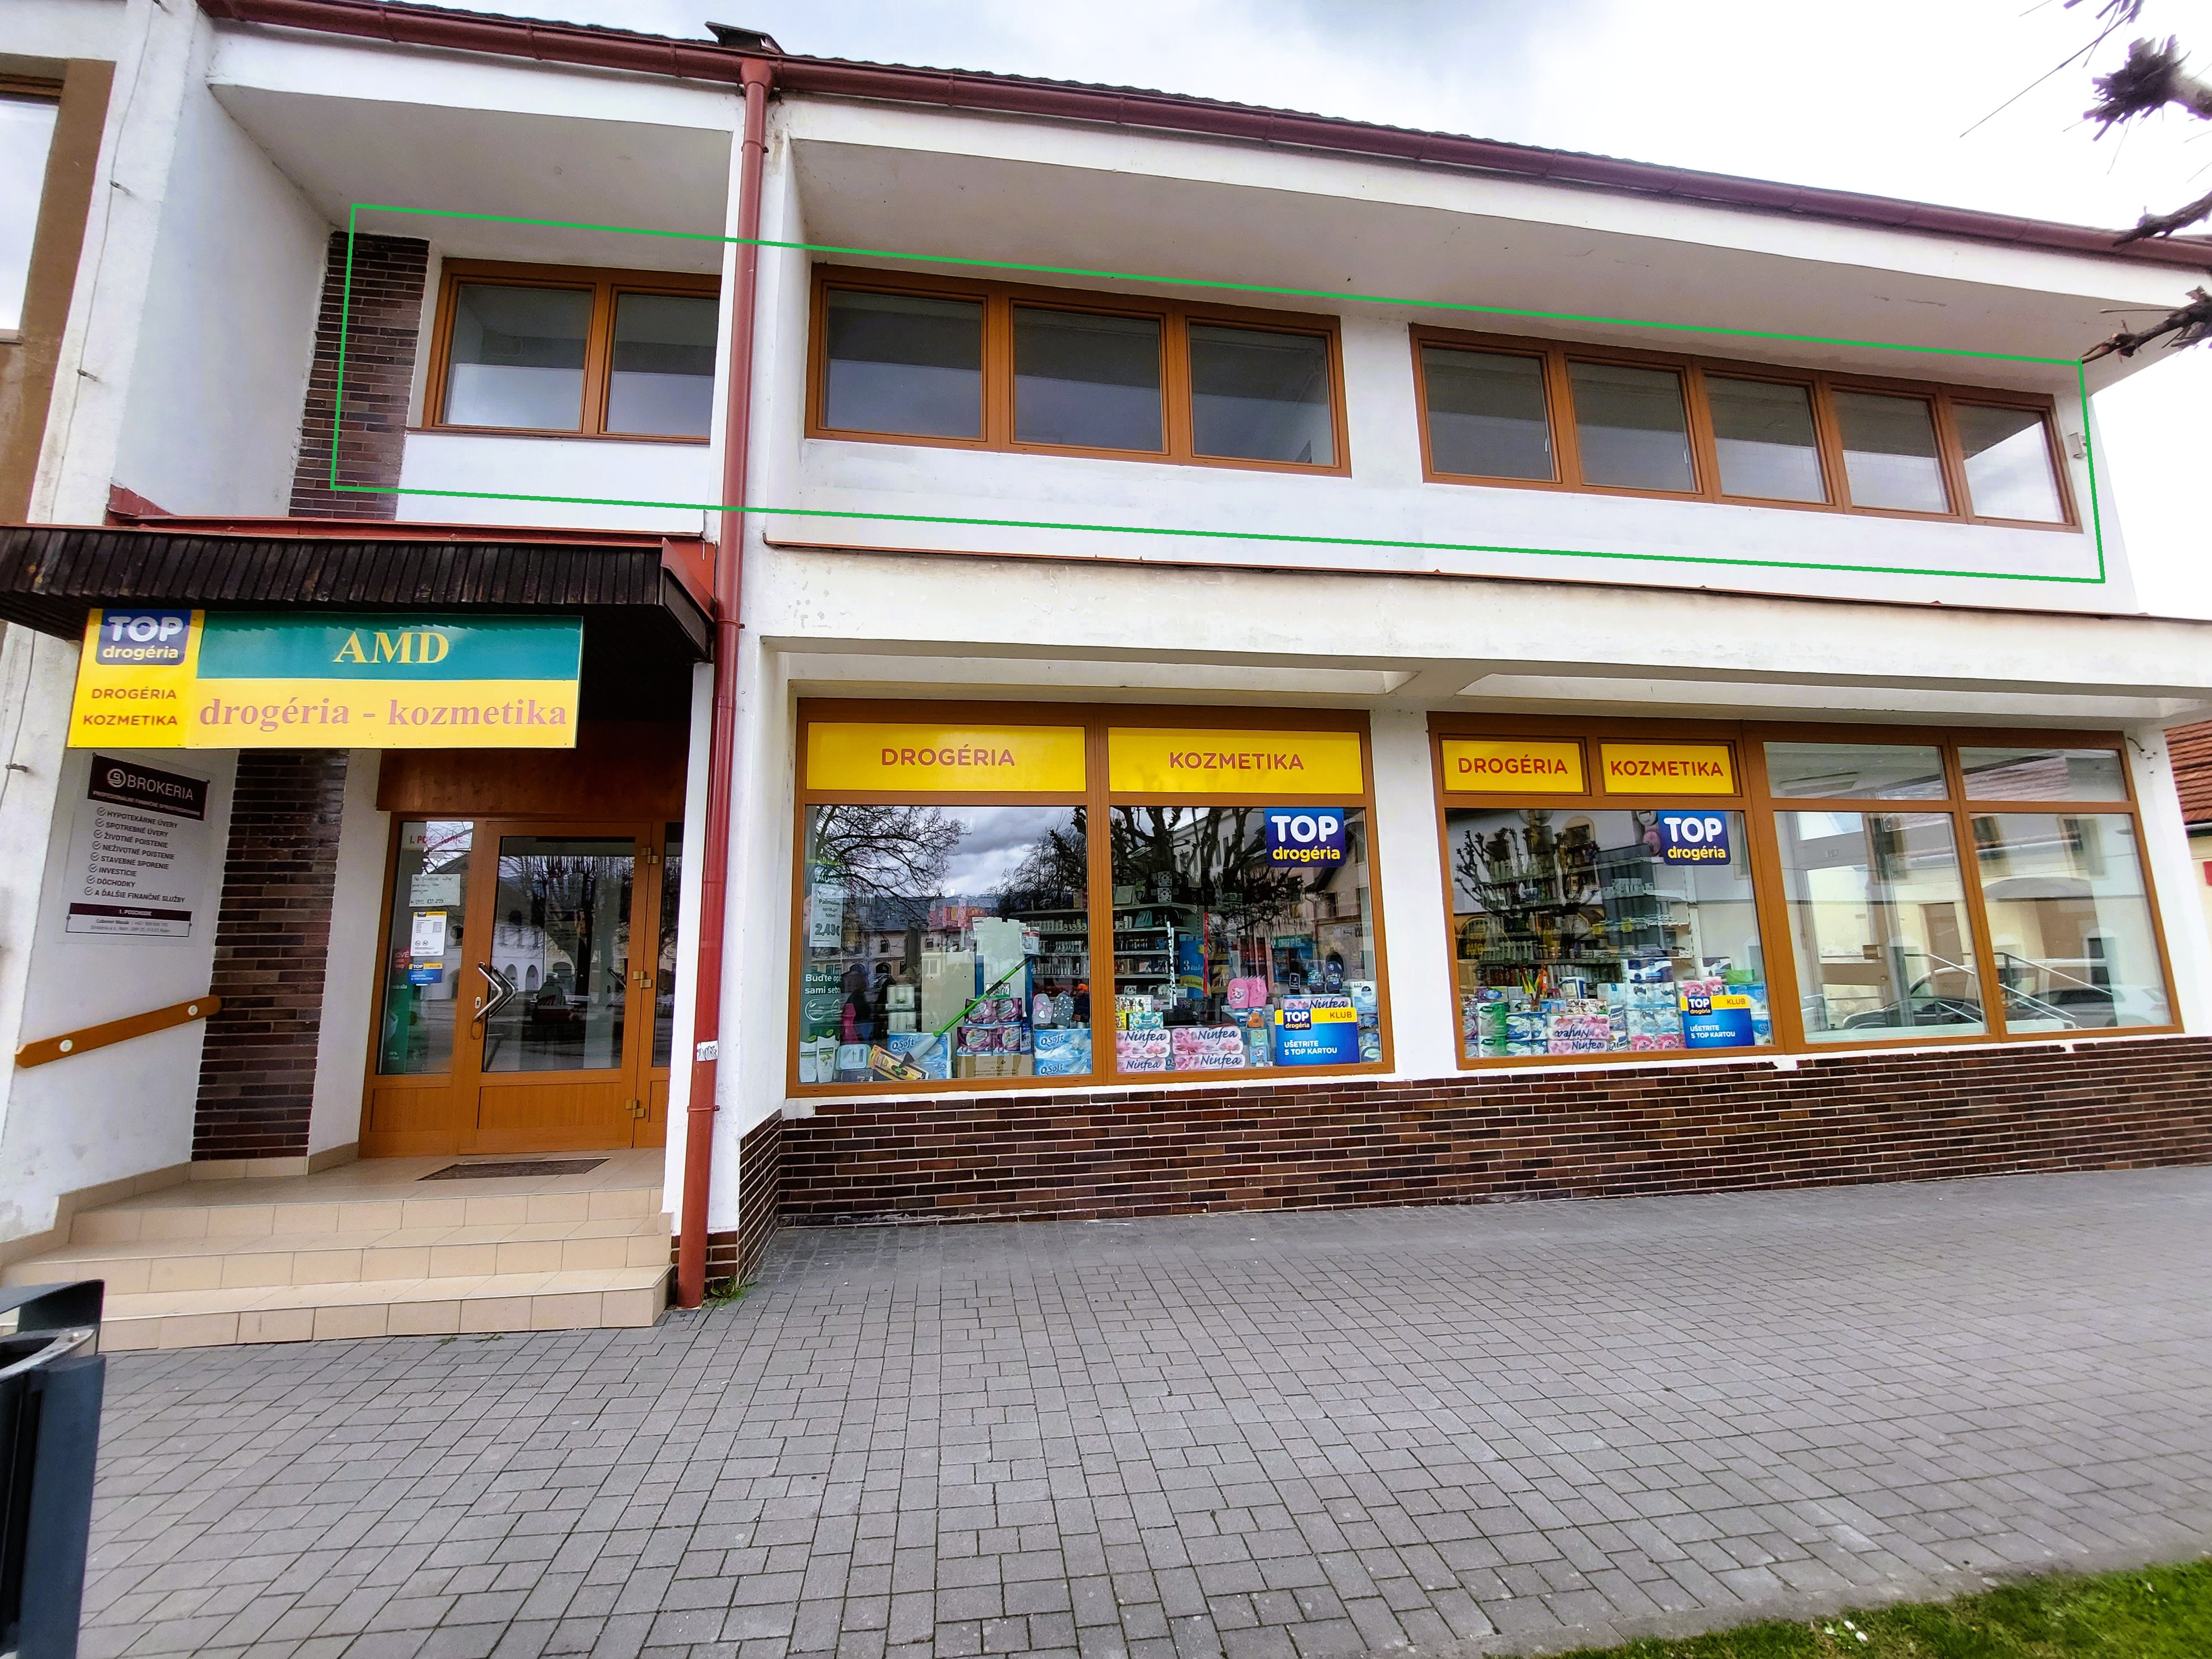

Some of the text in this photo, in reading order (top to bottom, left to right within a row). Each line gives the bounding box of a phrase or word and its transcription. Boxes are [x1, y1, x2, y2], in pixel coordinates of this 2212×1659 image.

[109, 616, 184, 643] TOP
[103, 644, 178, 662] drogéria
[333, 632, 449, 664] AMD
[92, 686, 177, 700] DROGÉRIA
[83, 714, 178, 727] KOZMETIKA
[200, 697, 349, 733] drogéria
[388, 699, 566, 726] kozmetika
[881, 744, 1015, 767] DROGÉRIA
[1169, 752, 1304, 770] KOZMETIKA
[1458, 754, 1568, 774] DROGÉRIA
[1610, 760, 1723, 776] KOZMETIKA
[127, 775, 193, 800] BROKERIA
[1271, 815, 1338, 842] TOP
[1663, 817, 1722, 842] TOP
[1272, 846, 1340, 862] drogéria
[1668, 845, 1726, 862] drogéria
[805, 974, 832, 982] Buďte
[1689, 999, 1709, 1008] TOP
[1285, 1011, 1309, 1022] TOP
[1125, 1030, 1166, 1047] Ninfea
[1198, 1026, 1238, 1045] Ninfea
[1572, 1039, 1603, 1052] Ninfea
[1126, 1058, 1161, 1071] Ninfea
[1201, 1052, 1241, 1068] Ninfea
